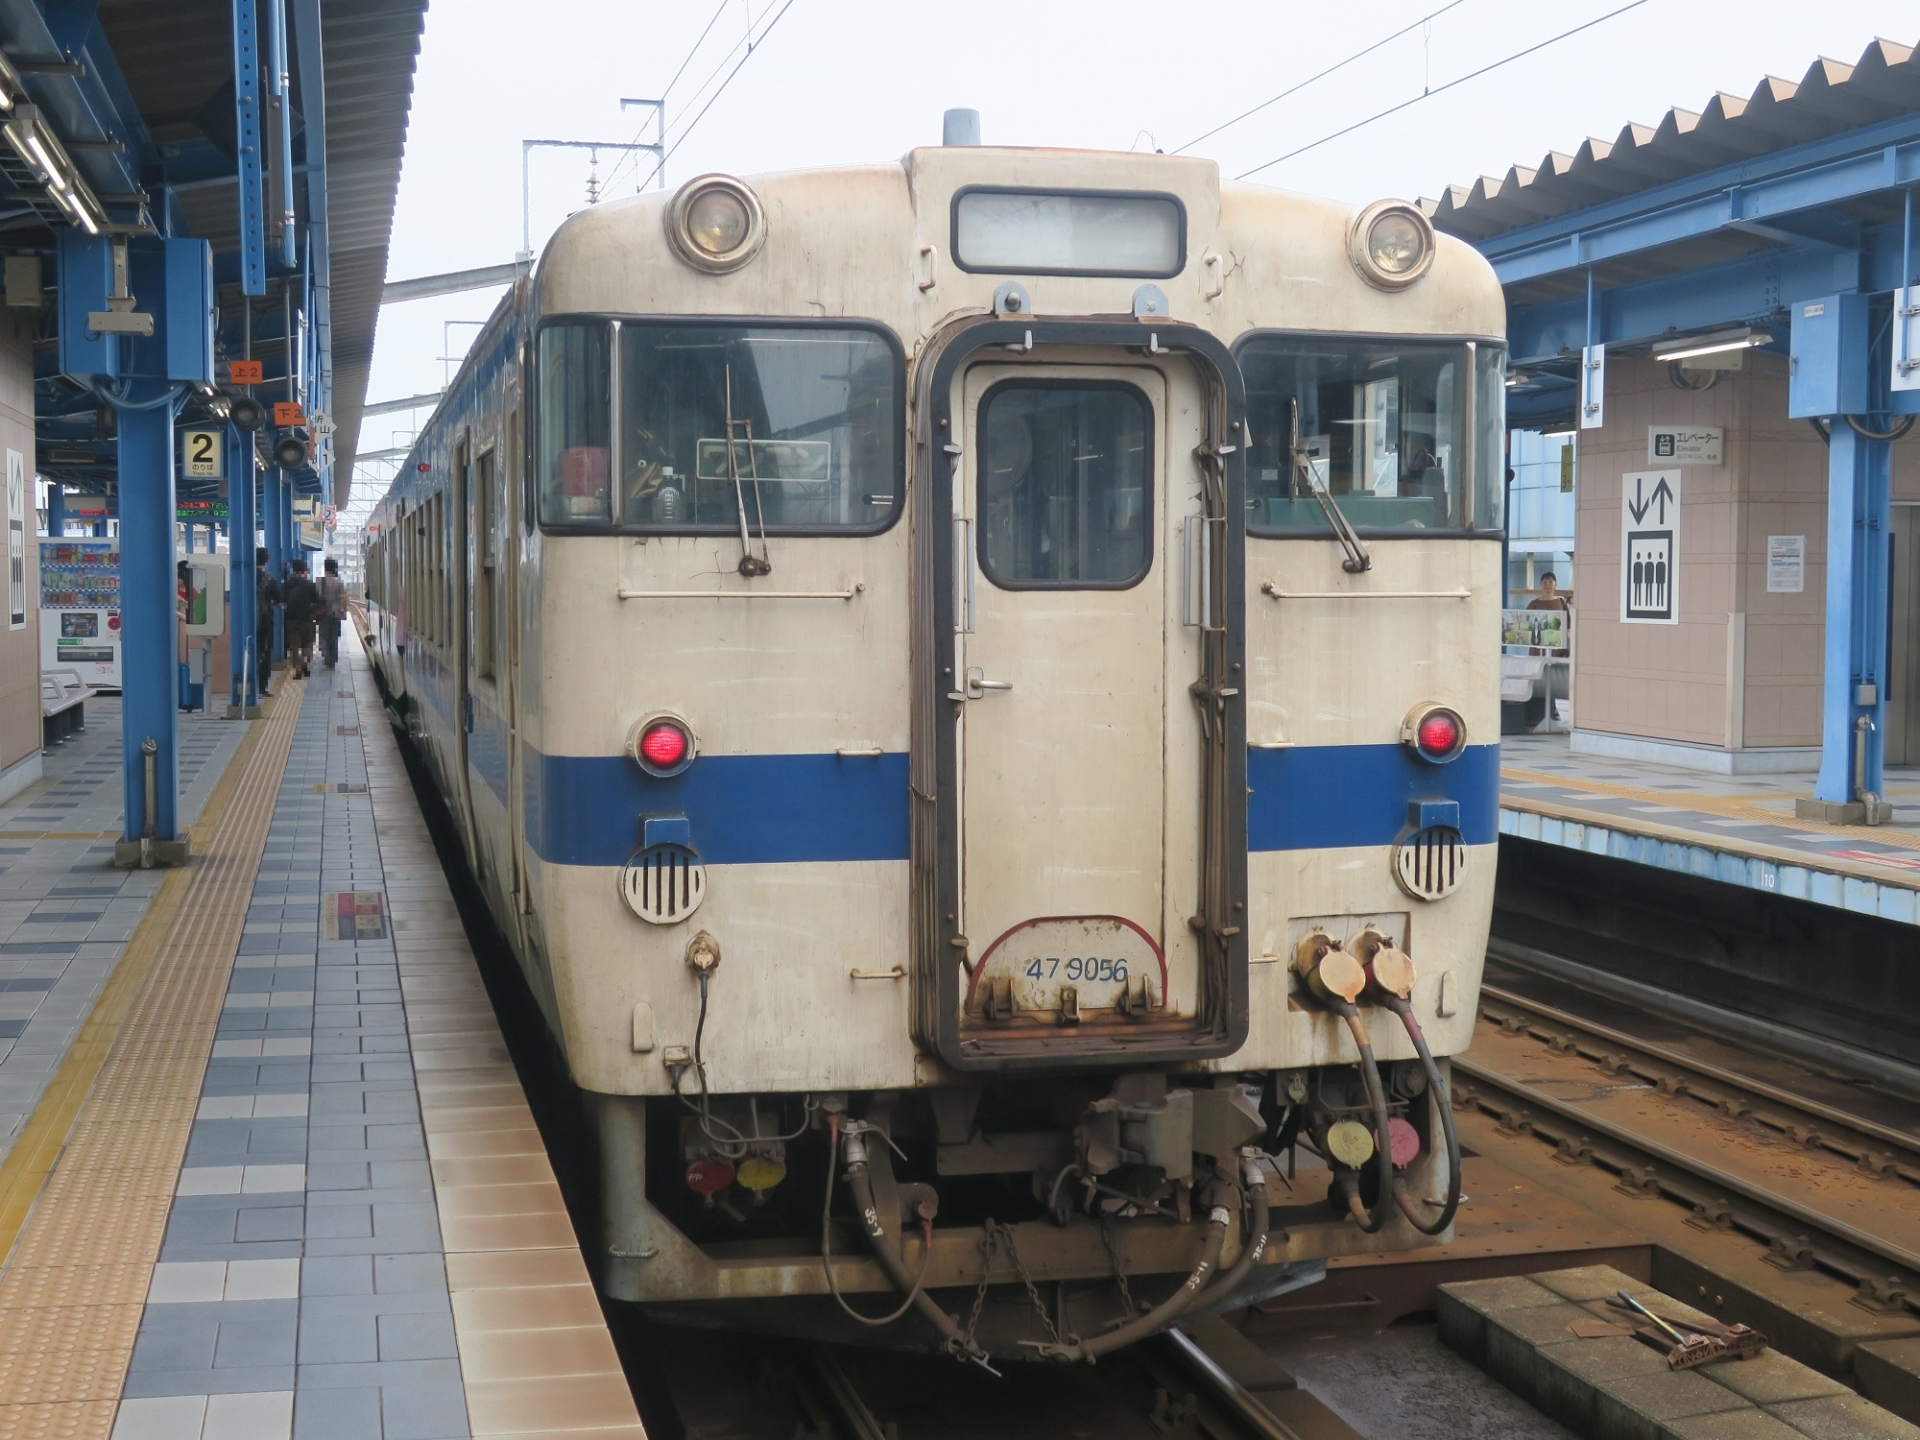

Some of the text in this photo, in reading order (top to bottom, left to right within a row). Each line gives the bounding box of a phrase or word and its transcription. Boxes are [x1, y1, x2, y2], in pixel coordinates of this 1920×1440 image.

[1677, 432, 1719, 444] エレベーター
[192, 433, 214, 463] 2
[1764, 873, 1775, 888] 10
